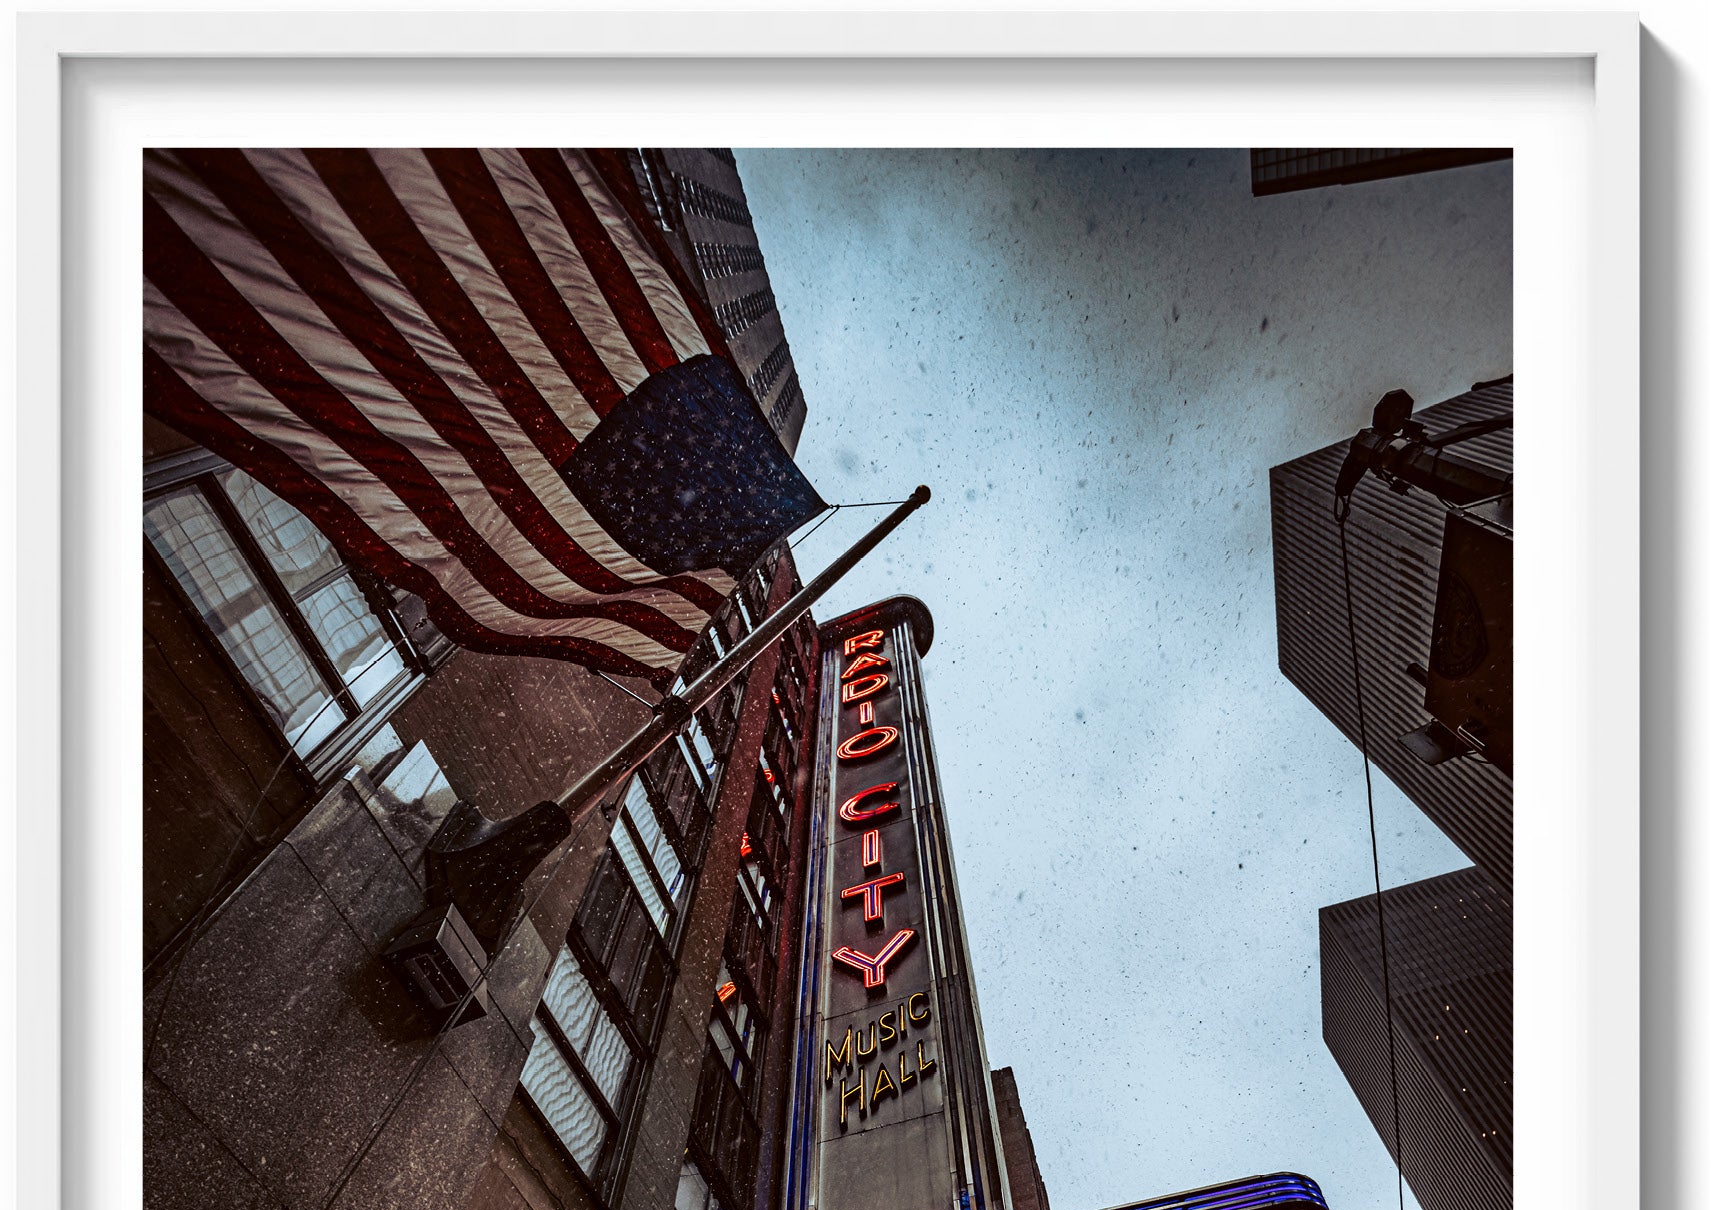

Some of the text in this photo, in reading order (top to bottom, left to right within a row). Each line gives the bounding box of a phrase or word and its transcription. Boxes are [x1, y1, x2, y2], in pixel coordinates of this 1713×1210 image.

[831, 629, 918, 989] RADIO CITY
[826, 991, 930, 1087] MUSIC
[839, 1039, 936, 1130] HALL
